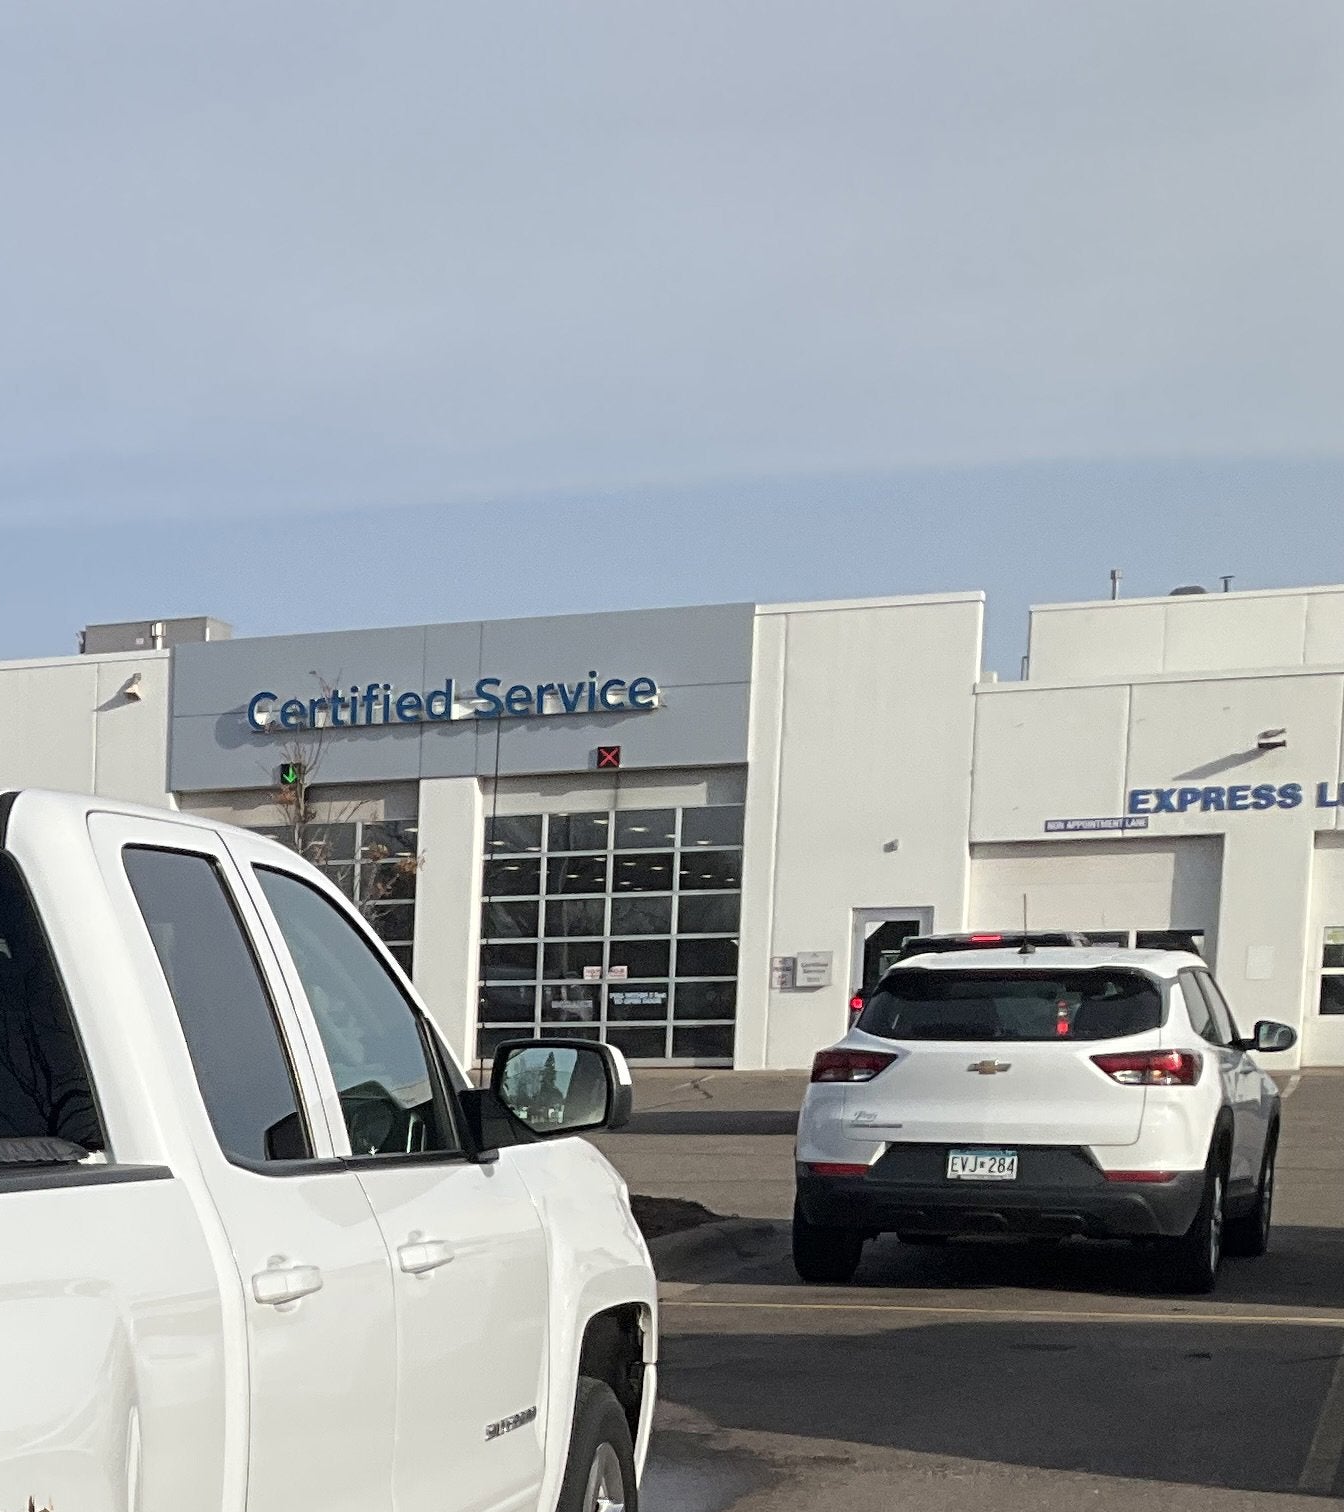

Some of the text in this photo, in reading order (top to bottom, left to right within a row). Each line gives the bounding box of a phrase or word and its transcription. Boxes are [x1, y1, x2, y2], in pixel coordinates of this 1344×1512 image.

[247, 670, 660, 731] Certified Service
[1128, 782, 1344, 814] EXPRESS L
[951, 1156, 1015, 1174] EVJ 284
